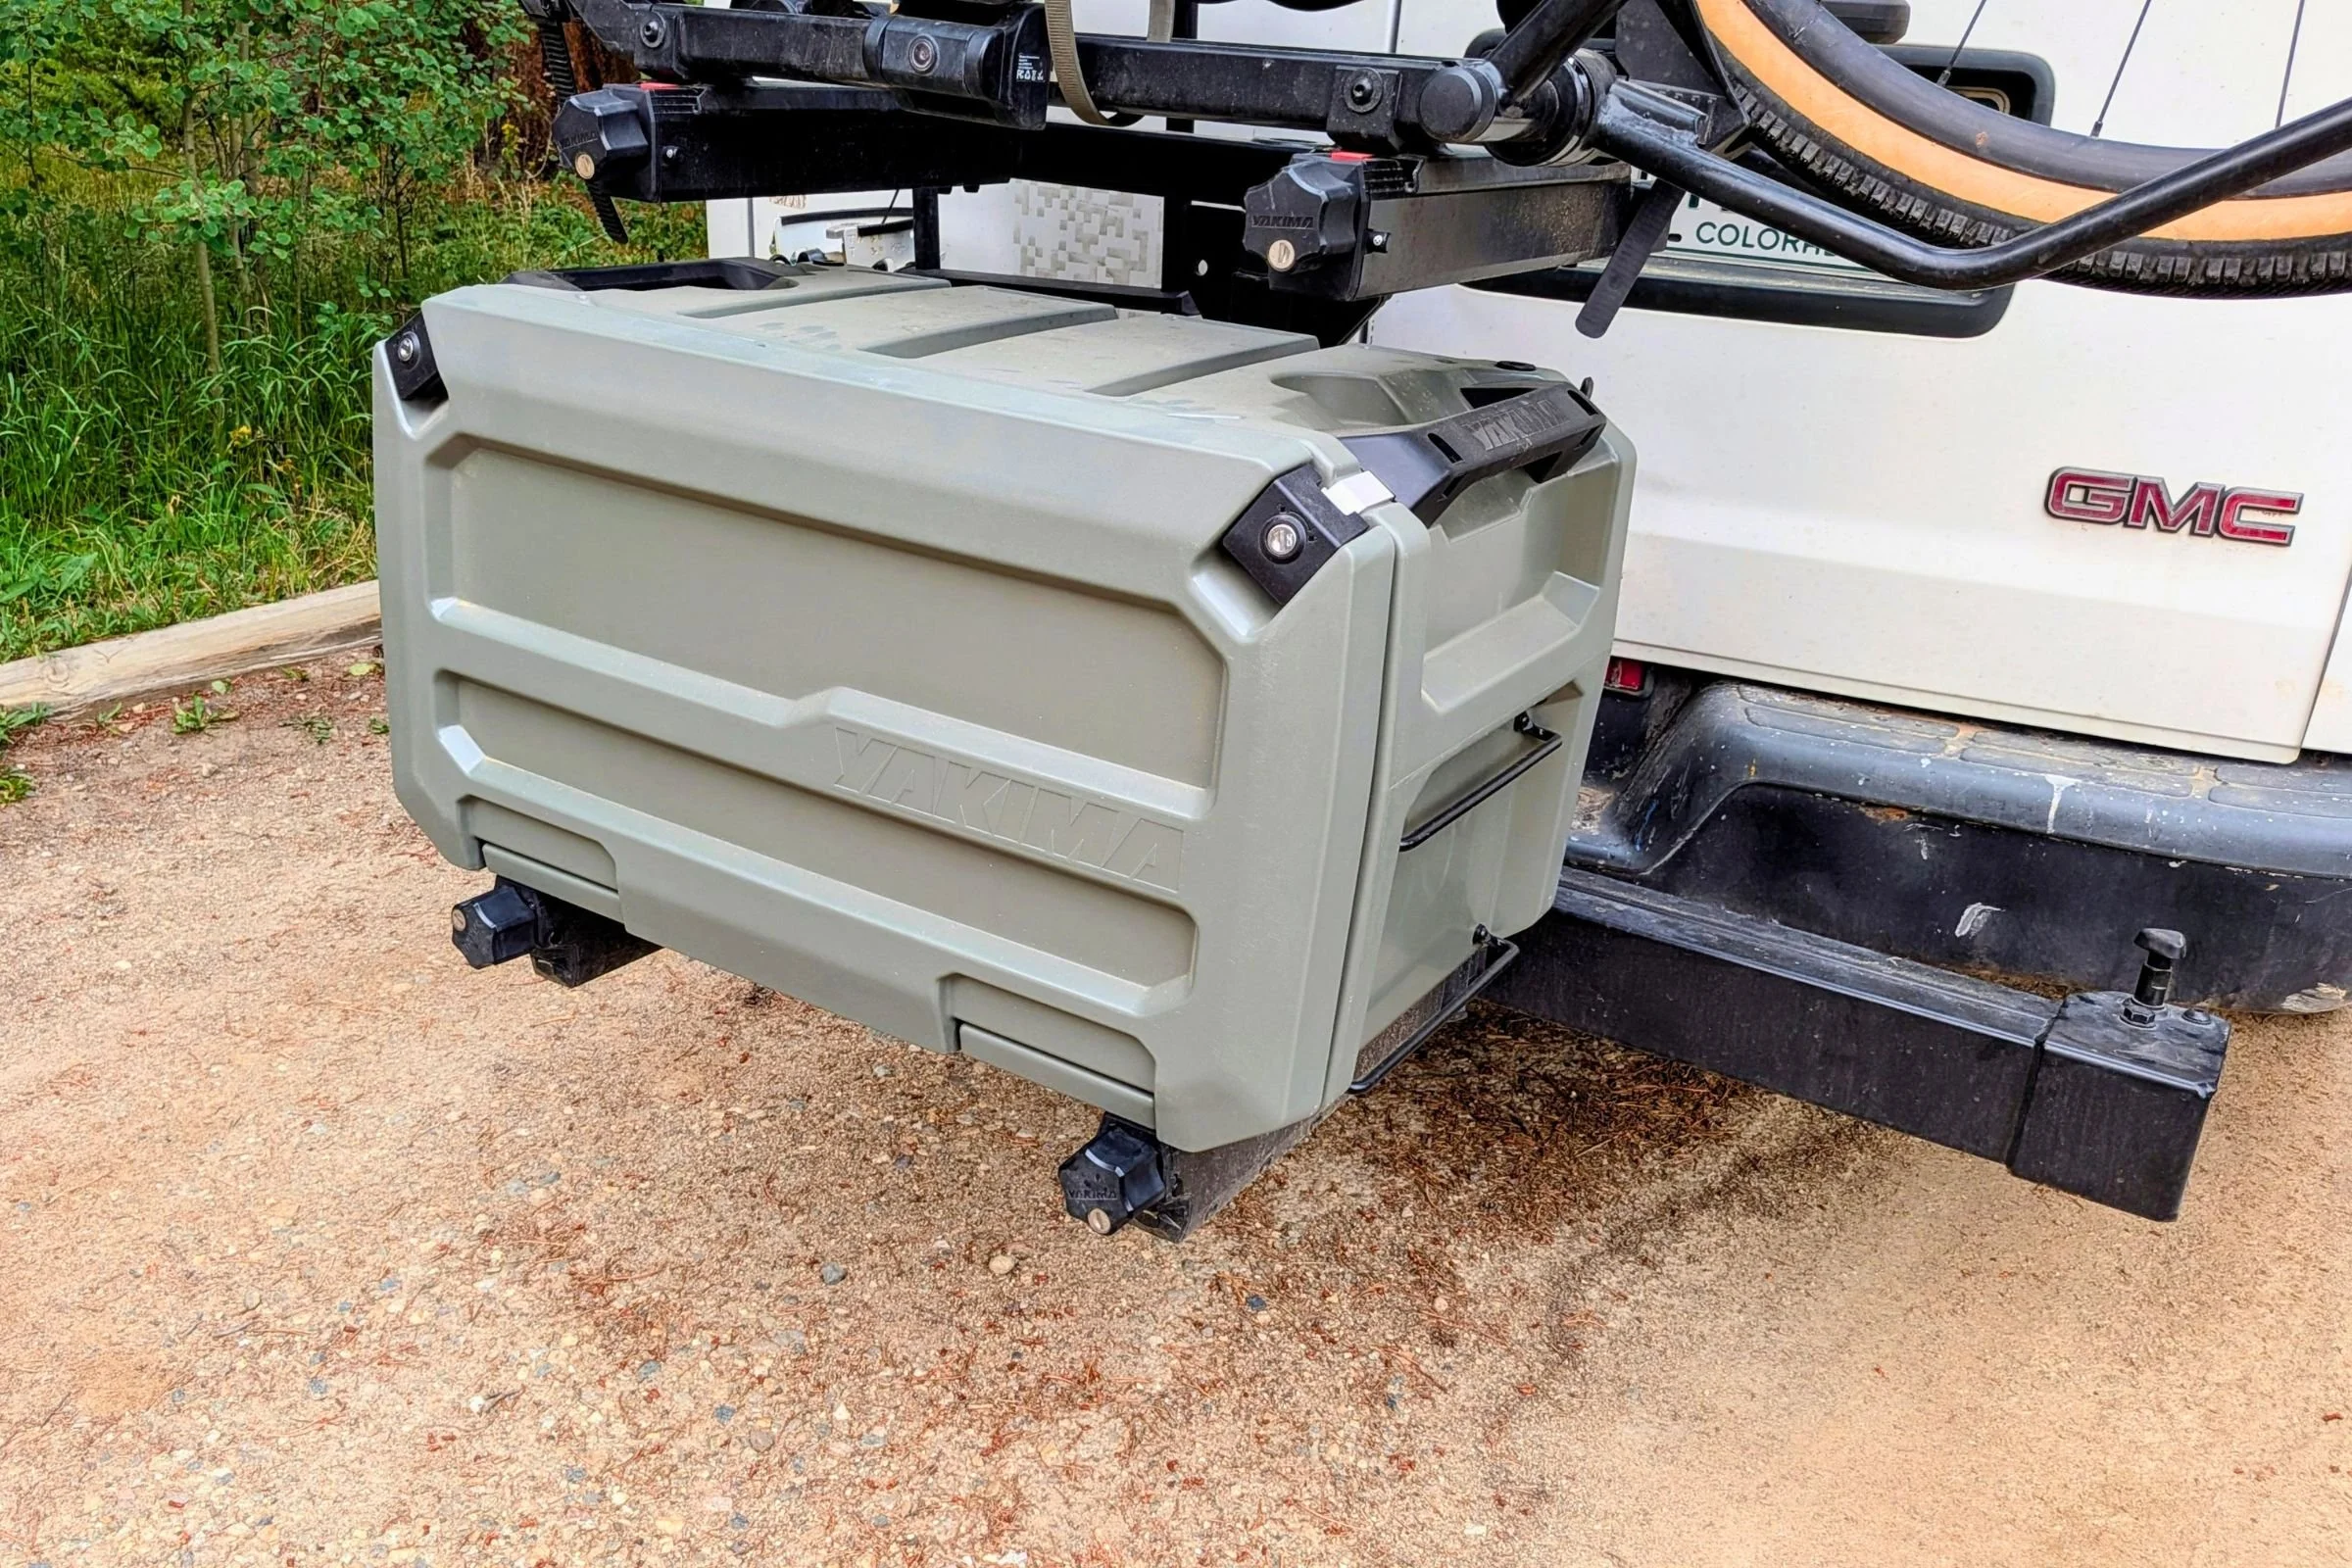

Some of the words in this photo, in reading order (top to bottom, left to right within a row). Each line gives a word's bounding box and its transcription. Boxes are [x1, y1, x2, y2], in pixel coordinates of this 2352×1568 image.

[1250, 215, 1314, 230] YAKIMA
[1695, 220, 1837, 257] COLOR
[1460, 398, 1570, 452] YAKIMA
[2044, 466, 2304, 547] GMC
[834, 727, 1185, 894] YAKIMA
[1067, 1189, 1118, 1200] YAKIMA
